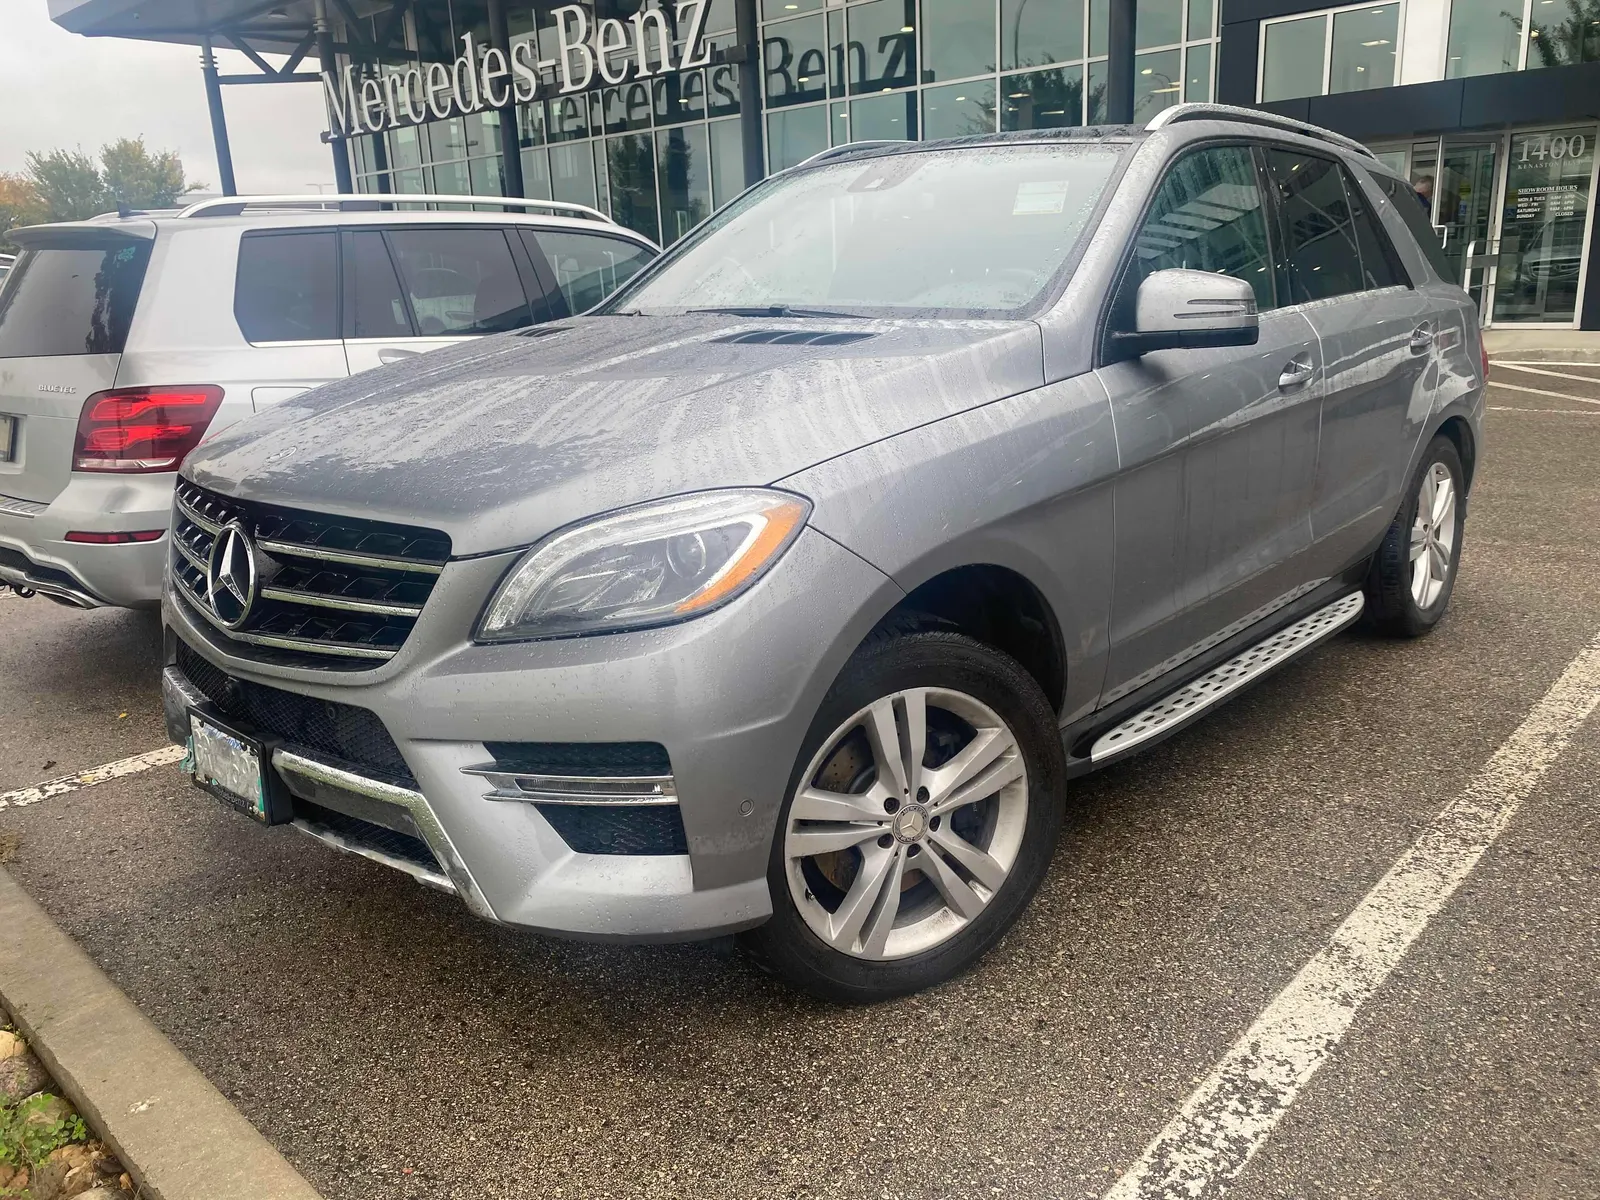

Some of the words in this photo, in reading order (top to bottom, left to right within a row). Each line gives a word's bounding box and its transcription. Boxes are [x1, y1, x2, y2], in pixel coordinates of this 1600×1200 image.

[319, 0, 712, 138] Mercedes-Benz
[1519, 134, 1585, 162] 1400
[1518, 161, 1559, 170] KENASTON
[1518, 186, 1555, 194] SHOWROOM
[38, 384, 76, 394] BLUETEC
